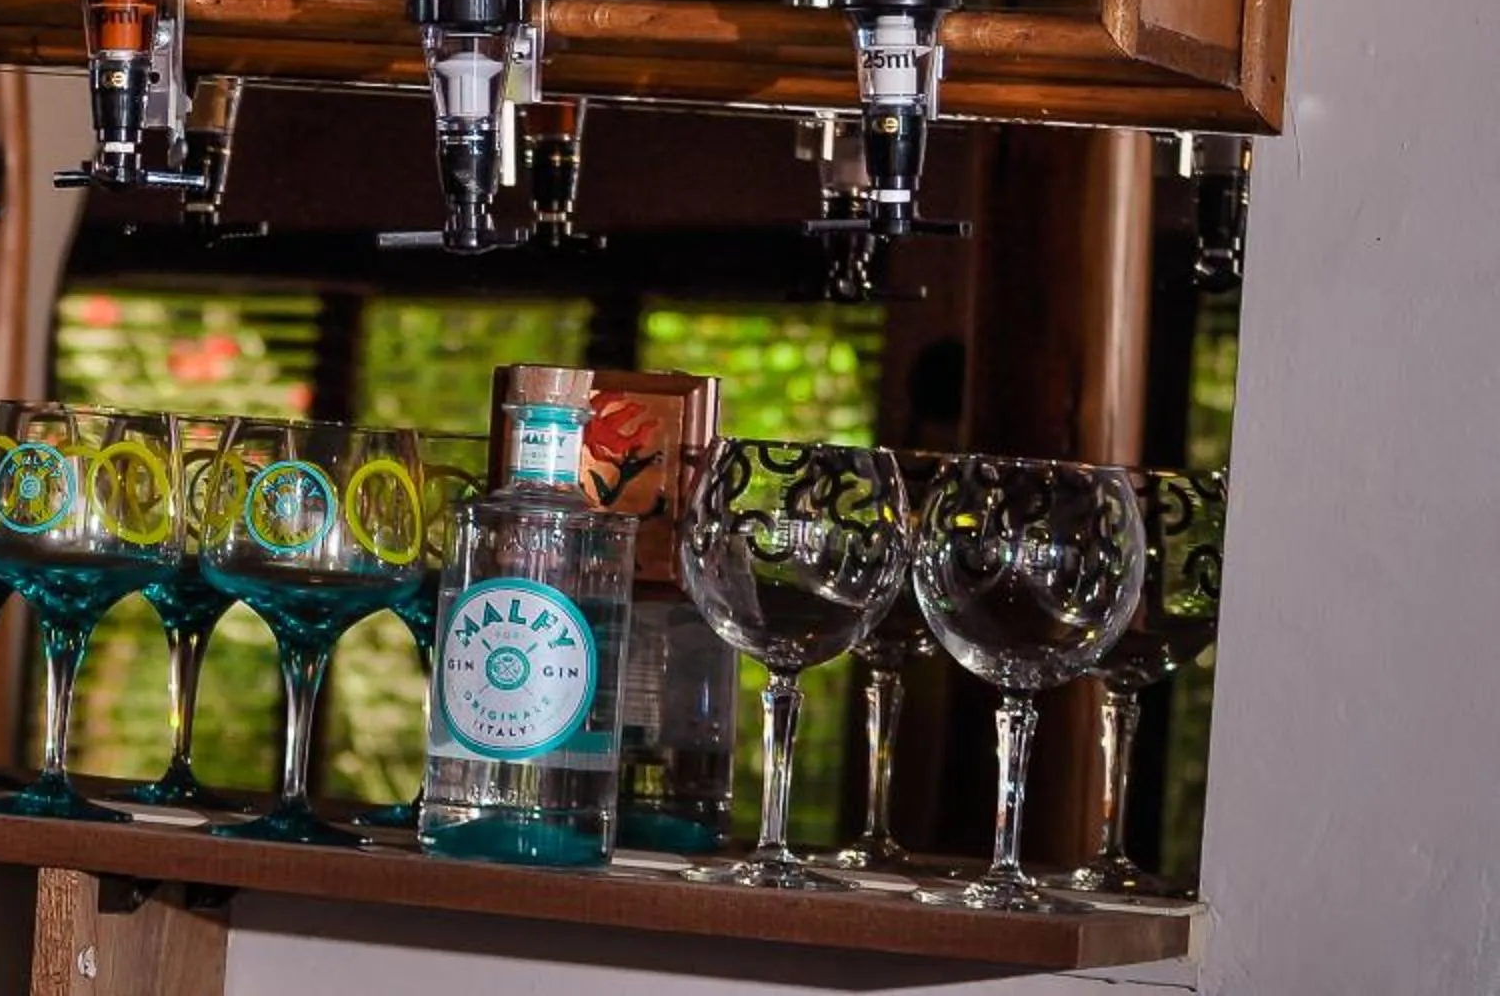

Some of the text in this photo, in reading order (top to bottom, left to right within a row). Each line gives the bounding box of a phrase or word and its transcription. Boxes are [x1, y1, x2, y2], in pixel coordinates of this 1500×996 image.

[521, 433, 566, 448] MALY
[454, 599, 576, 649] MALFY
[447, 658, 580, 679] GIN GIN
